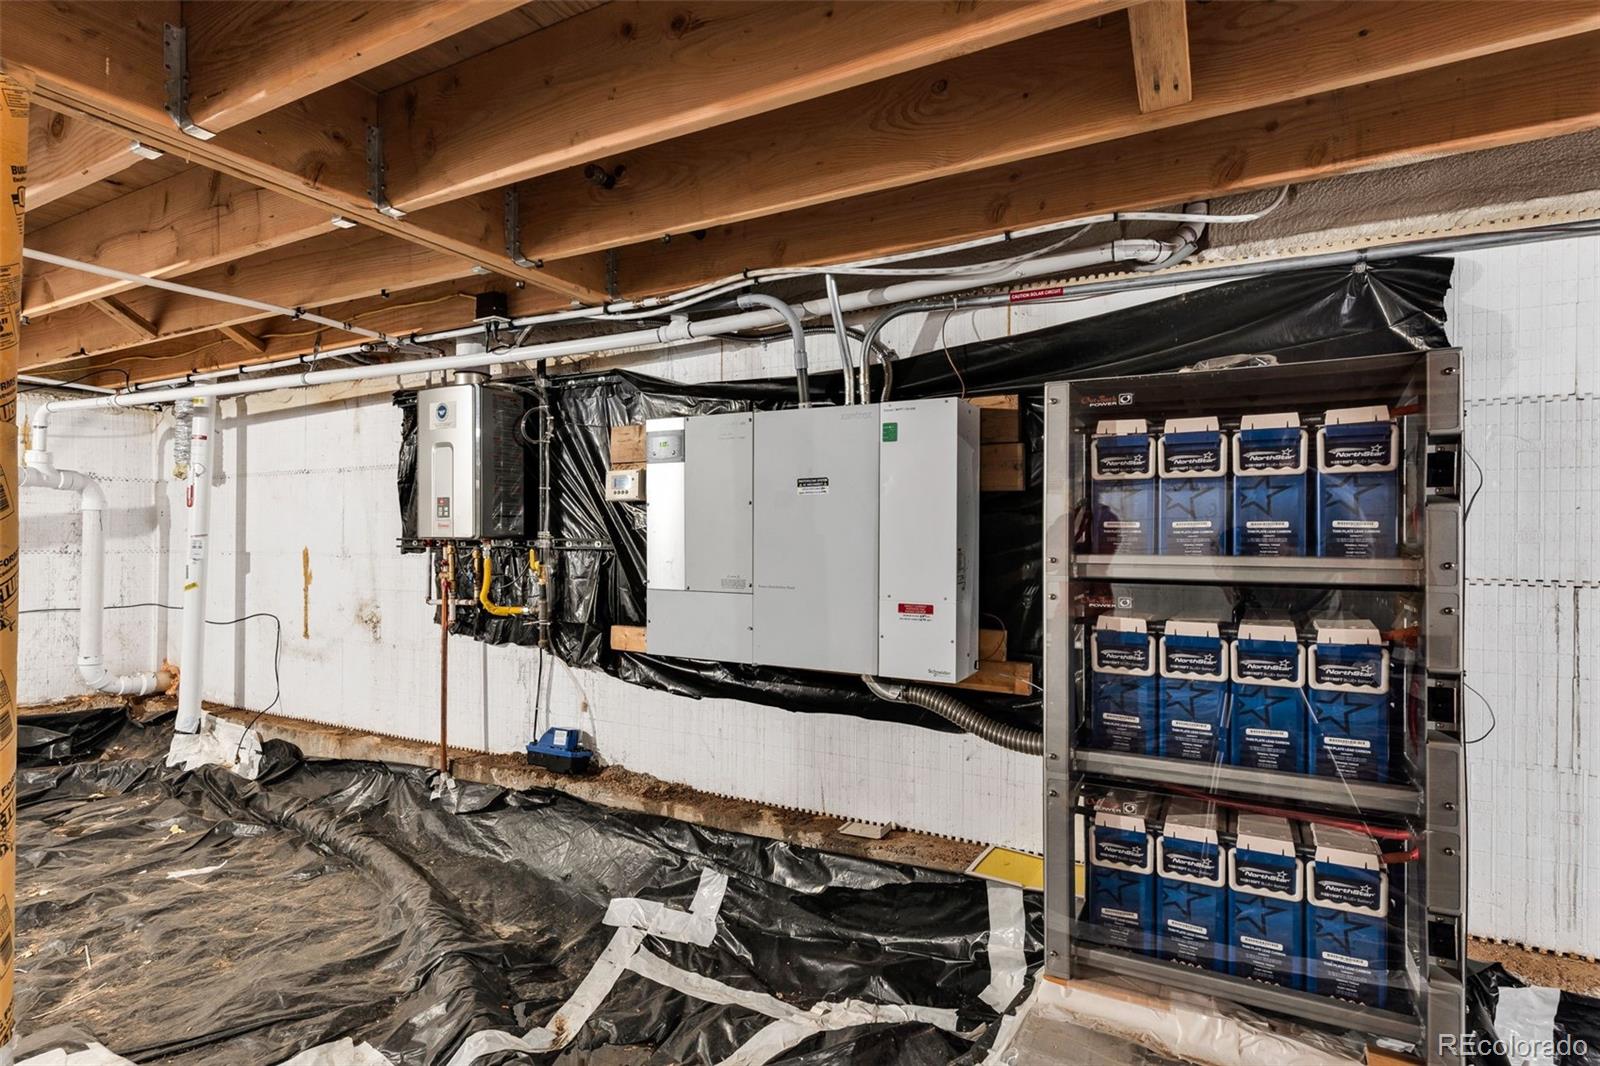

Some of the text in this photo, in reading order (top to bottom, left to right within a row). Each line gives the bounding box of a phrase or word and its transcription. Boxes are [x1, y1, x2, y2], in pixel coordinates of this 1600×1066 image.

[1011, 292, 1030, 300] CAUTION
[1335, 450, 1385, 458] NorthStar
[1105, 459, 1146, 467] NorthStar
[1173, 457, 1217, 465] NorthStar
[1174, 657, 1217, 665] NorthStar
[1246, 663, 1294, 671] NorthStar
[1325, 669, 1376, 677] NorthStar
[1104, 846, 1144, 857] NorthStar
[1172, 857, 1215, 869] NorthStar
[1244, 871, 1292, 883] NorthStar
[1325, 885, 1375, 898] NorthStar
